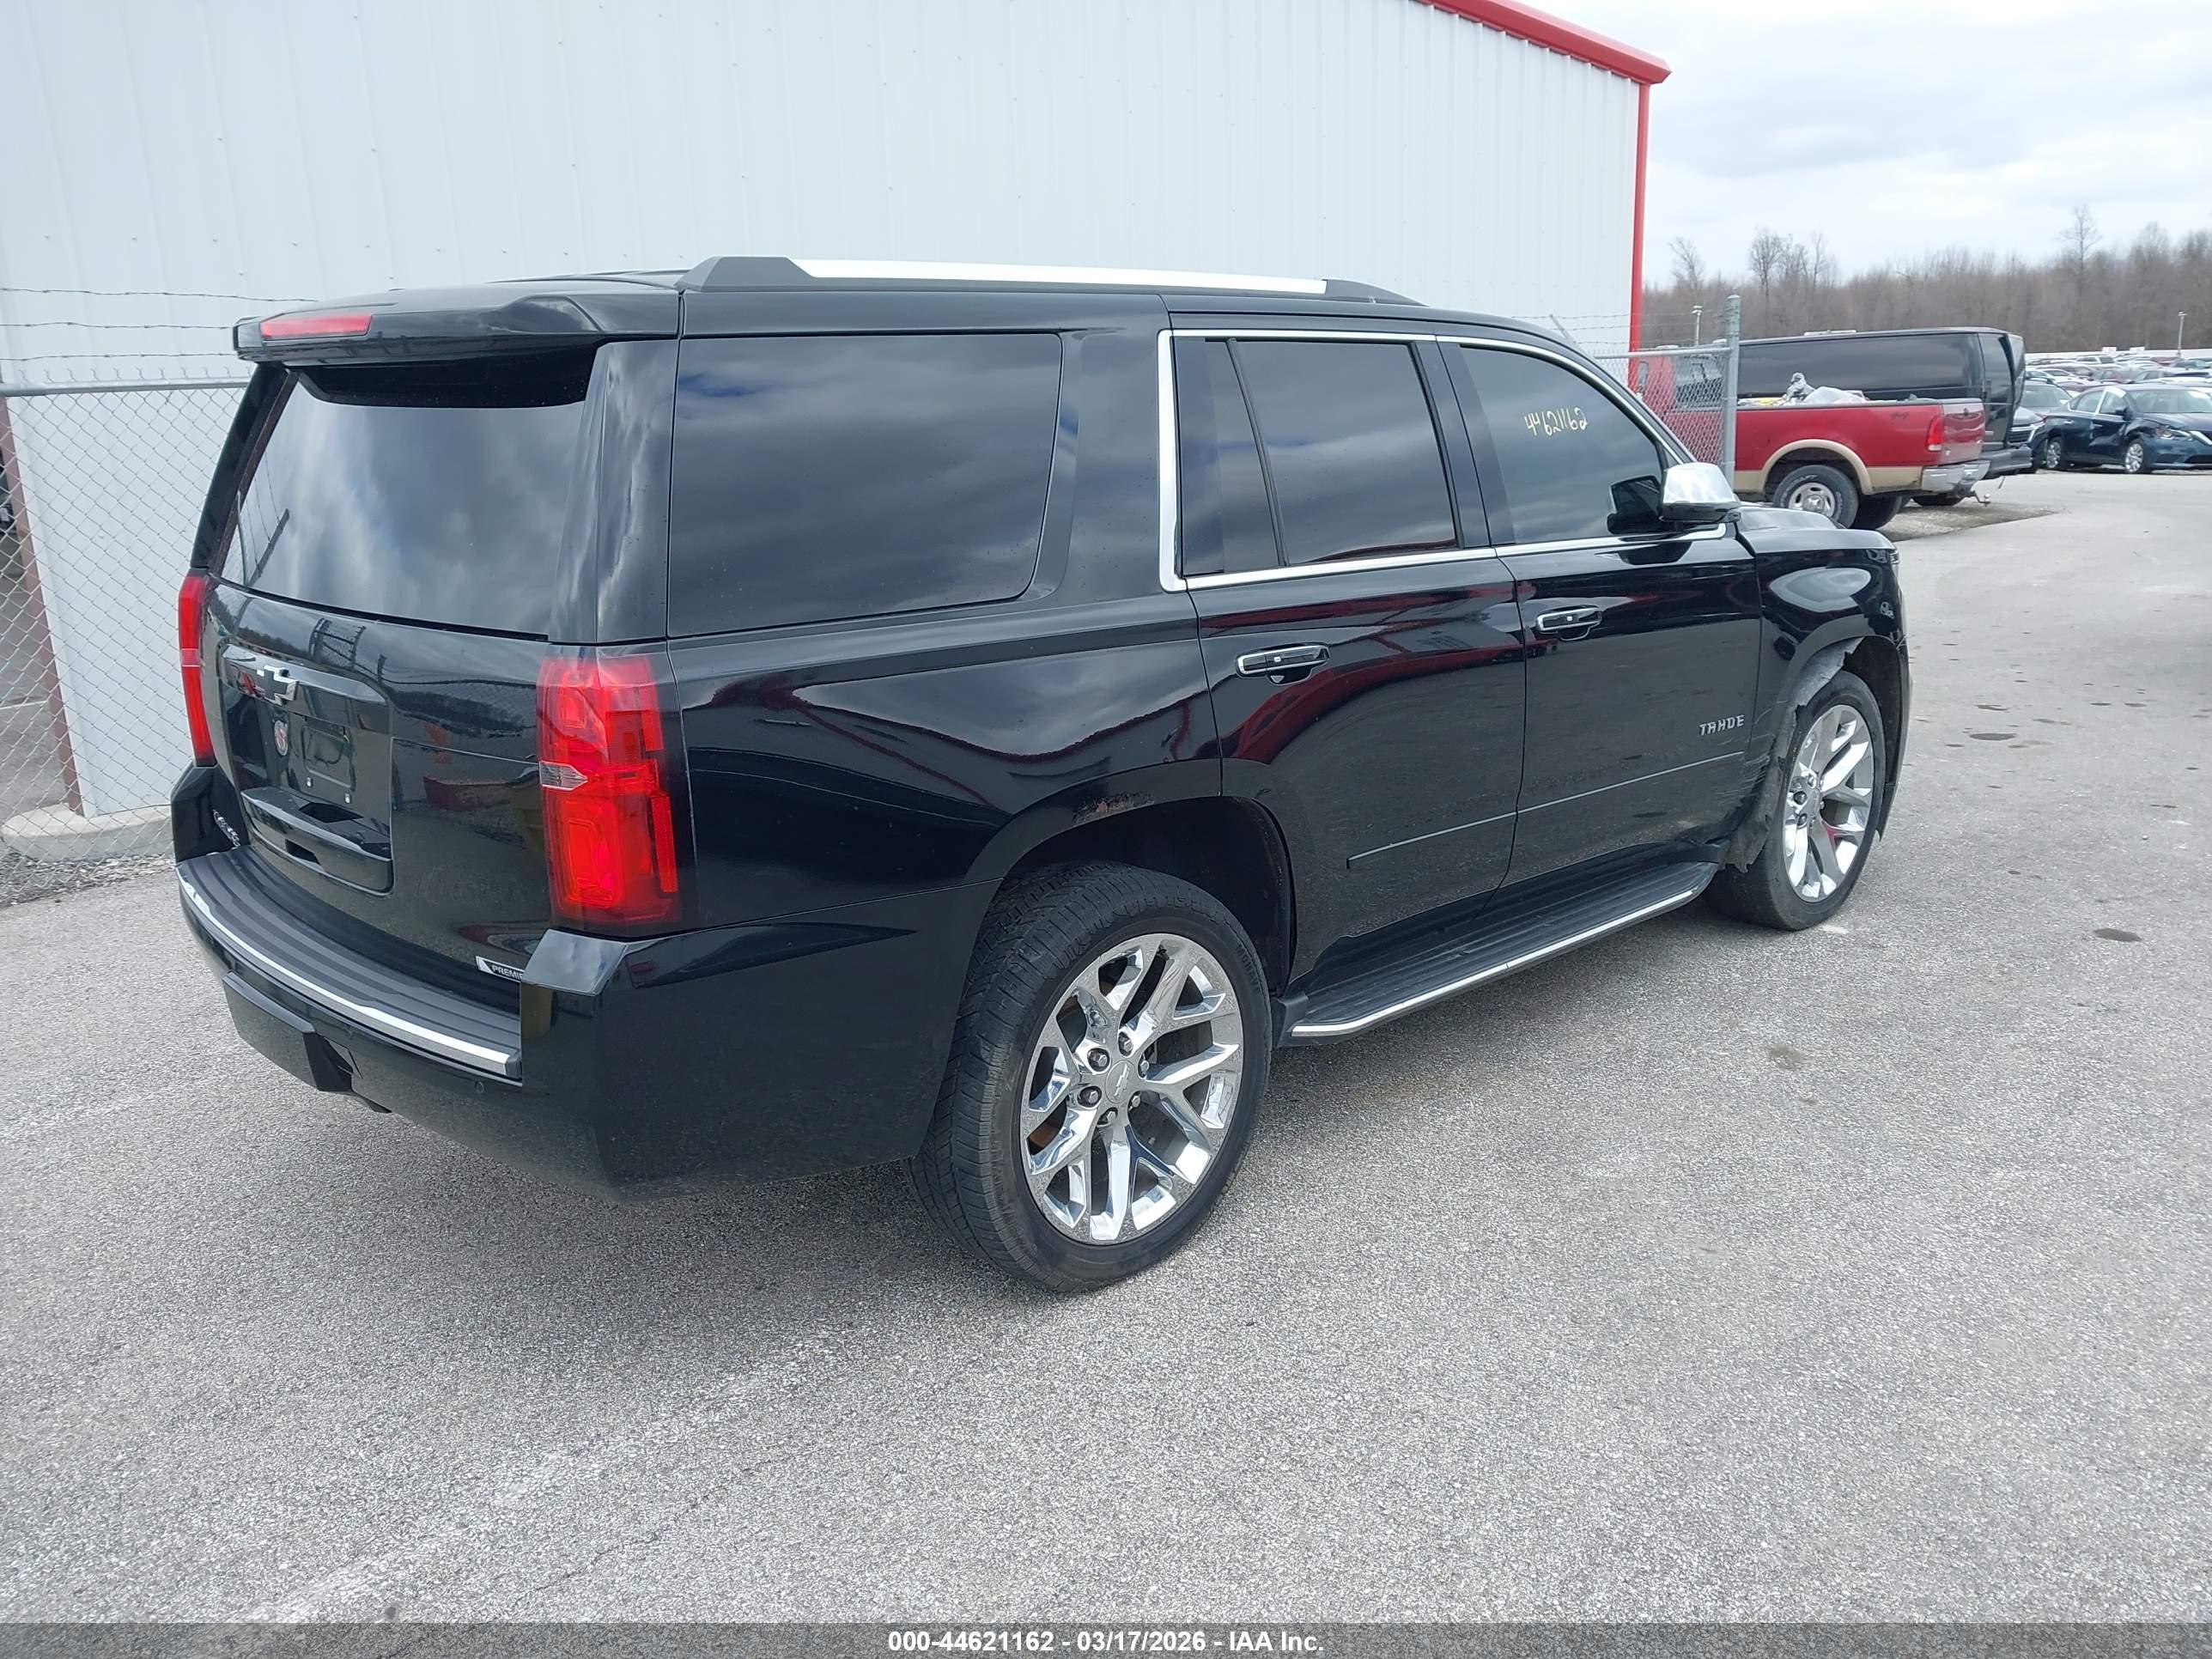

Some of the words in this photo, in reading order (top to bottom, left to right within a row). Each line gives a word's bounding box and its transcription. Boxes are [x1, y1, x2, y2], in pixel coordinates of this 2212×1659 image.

[1524, 407, 1588, 436] 44621162
[1699, 714, 1745, 736] TAHOE
[491, 964, 524, 981] PREMIE
